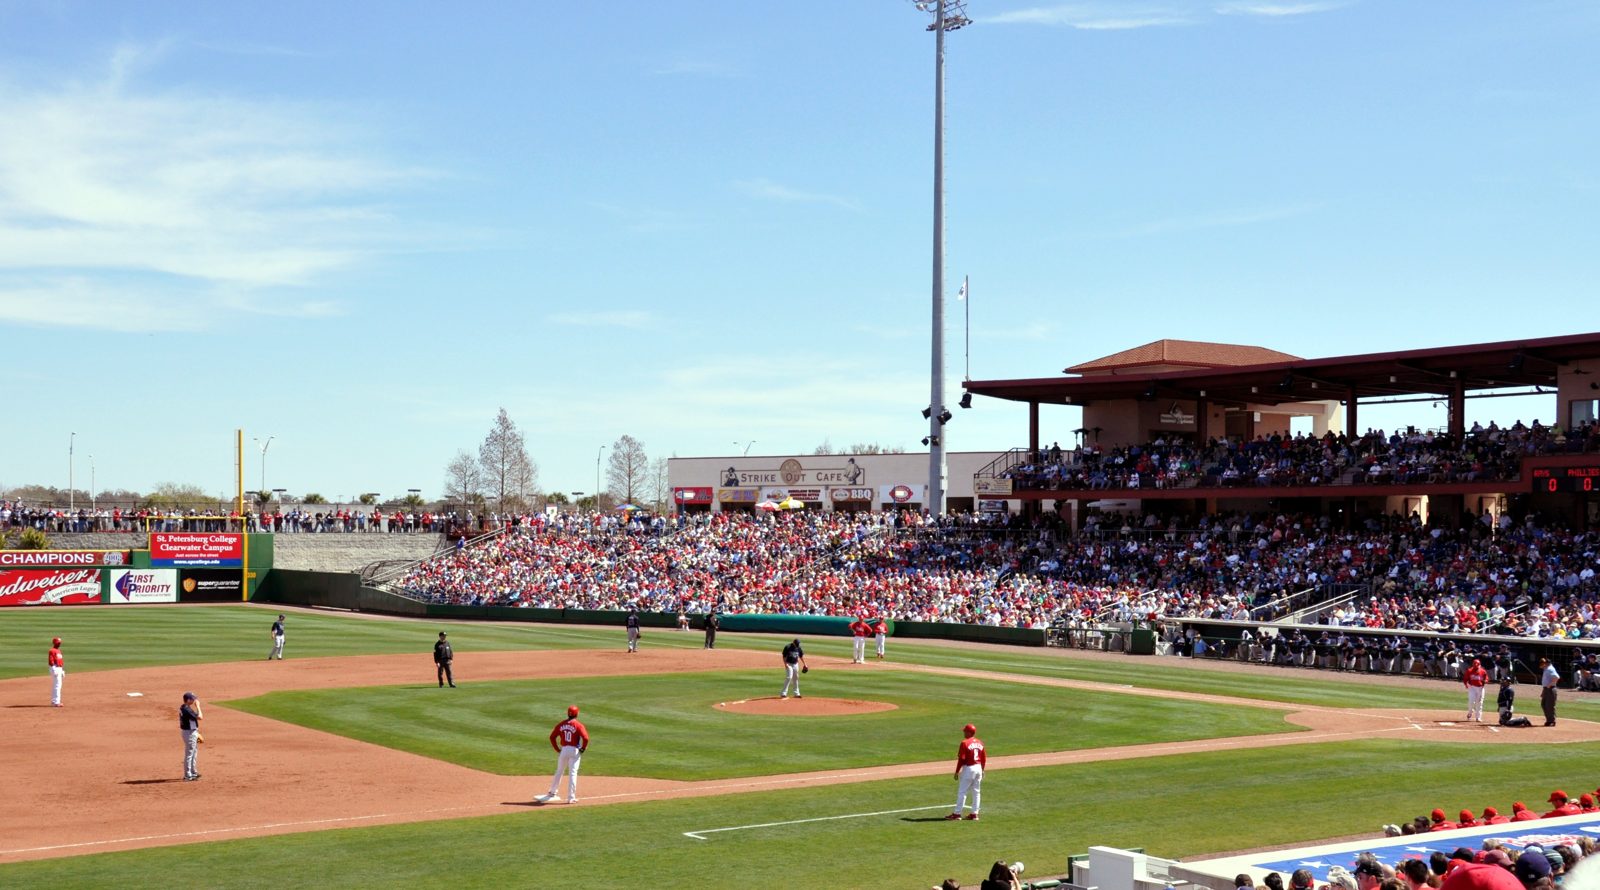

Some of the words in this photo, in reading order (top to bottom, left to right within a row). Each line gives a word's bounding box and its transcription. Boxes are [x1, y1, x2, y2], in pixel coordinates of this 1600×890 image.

[741, 473, 777, 482] STRIKE
[785, 472, 807, 482] OUT
[1567, 468, 1600, 477] PHILLIES
[1548, 478, 1557, 492] 0
[1583, 477, 1592, 491] 0
[851, 489, 872, 500] BBQ
[168, 535, 209, 545] Petersburg
[209, 535, 237, 544] College
[202, 544, 233, 552] Campus
[1, 553, 95, 564] CHAMPIONS
[126, 574, 154, 584] FIRST
[51, 587, 79, 598] American
[80, 585, 97, 593] Lager
[128, 584, 171, 597] PRIORITY
[564, 730, 572, 742] 10
